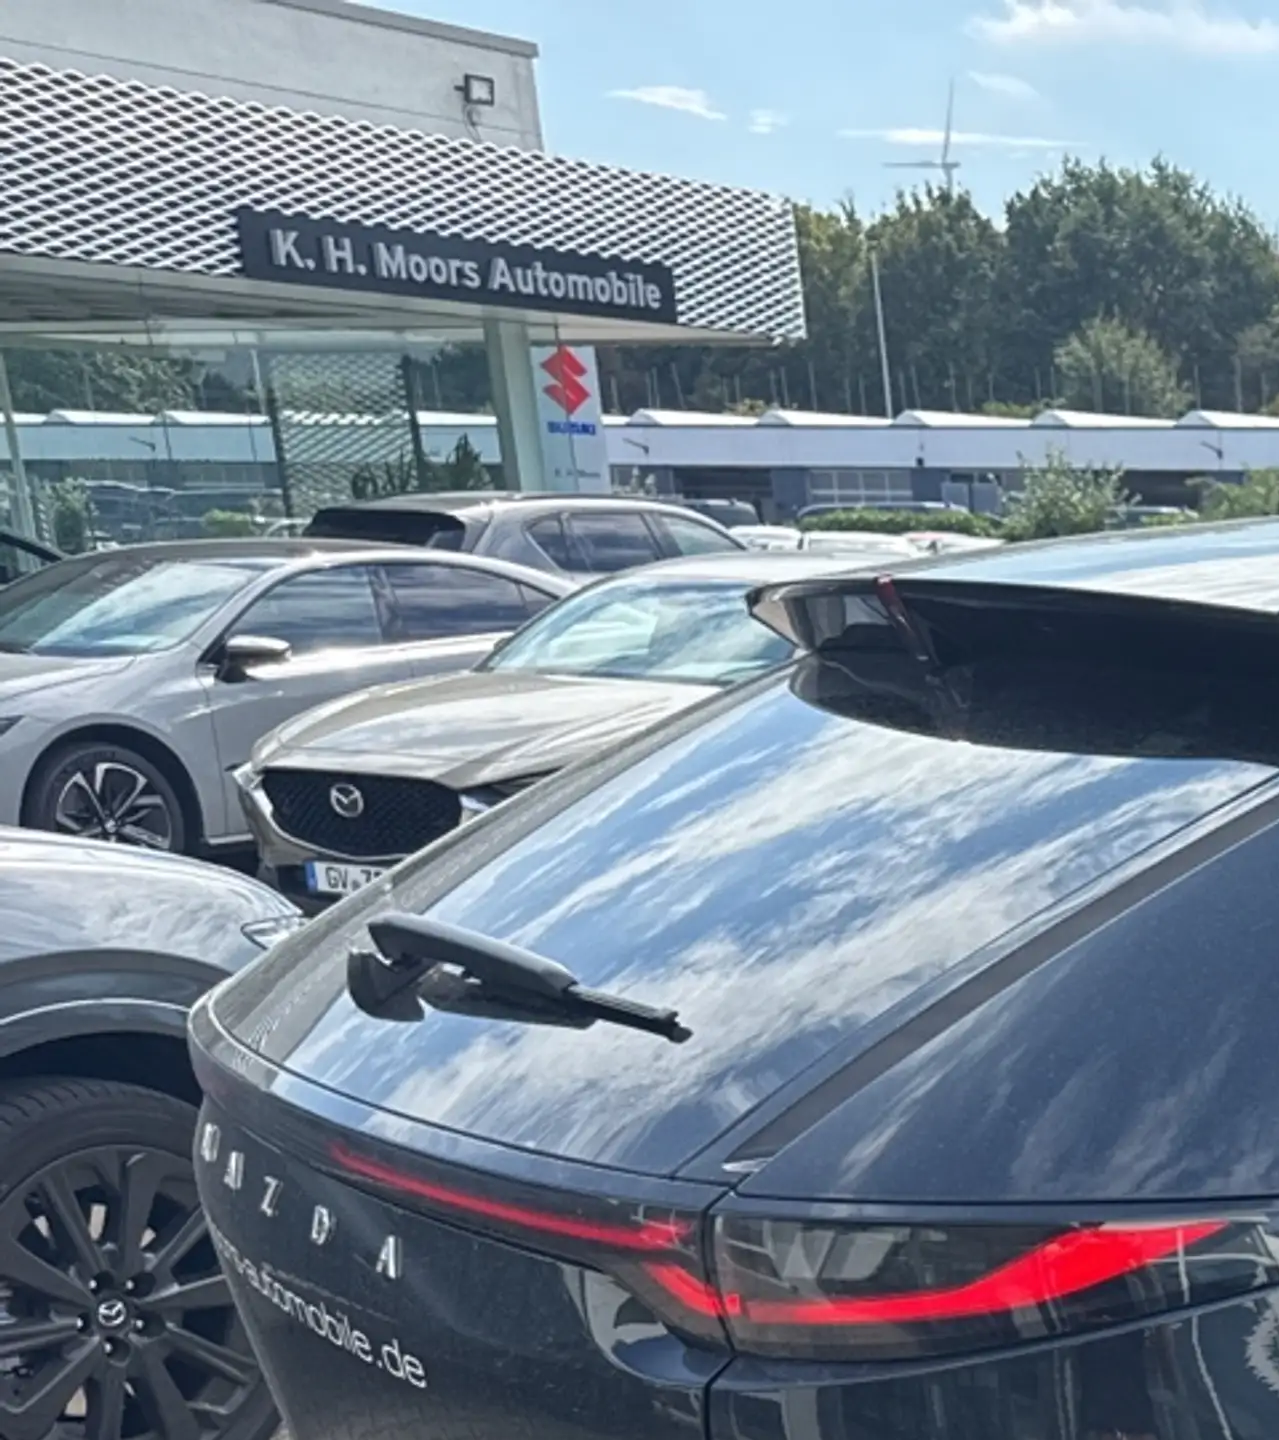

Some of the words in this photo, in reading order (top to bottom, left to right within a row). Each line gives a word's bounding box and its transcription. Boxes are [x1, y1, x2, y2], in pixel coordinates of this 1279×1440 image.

[270, 228, 316, 271] K.
[321, 234, 368, 277] H.
[373, 241, 482, 289] Moors
[488, 256, 662, 310] Automobile
[201, 1122, 400, 1280] MAZDA
